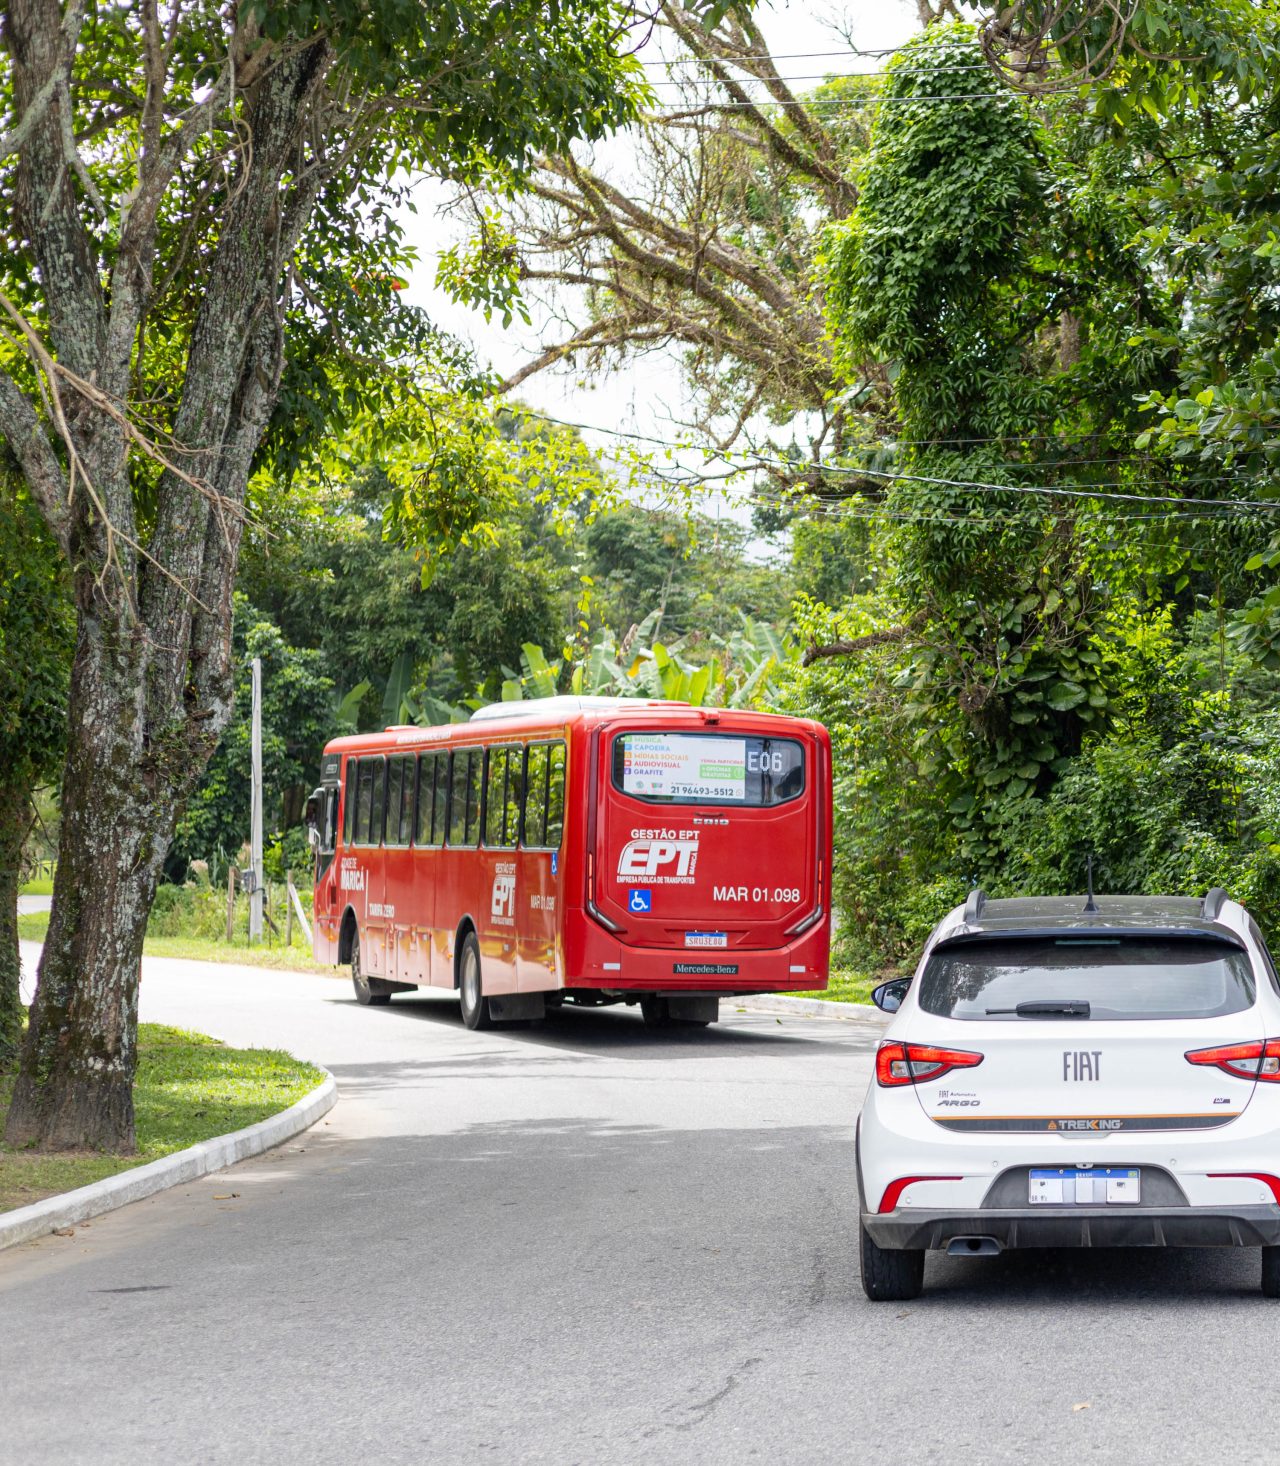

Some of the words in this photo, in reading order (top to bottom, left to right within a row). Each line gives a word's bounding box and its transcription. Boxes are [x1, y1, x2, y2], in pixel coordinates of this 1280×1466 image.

[660, 753, 689, 761] SOCIAIS
[748, 751, 783, 772] E06
[634, 760, 681, 769] AUDIOVISUAL
[633, 768, 664, 776] GRAFITE
[671, 786, 680, 794] 21
[682, 786, 734, 797] 96493-5512
[631, 828, 677, 840] GESTÃO
[679, 830, 700, 840] EPT
[617, 839, 699, 876] EPT
[340, 866, 364, 891] MARICÁ
[617, 876, 638, 884] EMPRESA
[664, 876, 695, 885] TRANSPORTES
[491, 874, 516, 917] EPT
[714, 886, 748, 902] MAR
[752, 888, 800, 902] 01.098
[676, 964, 736, 974] Mercedes-Benz
[1063, 1051, 1102, 1081] FIAT
[938, 1090, 949, 1098] FIAT
